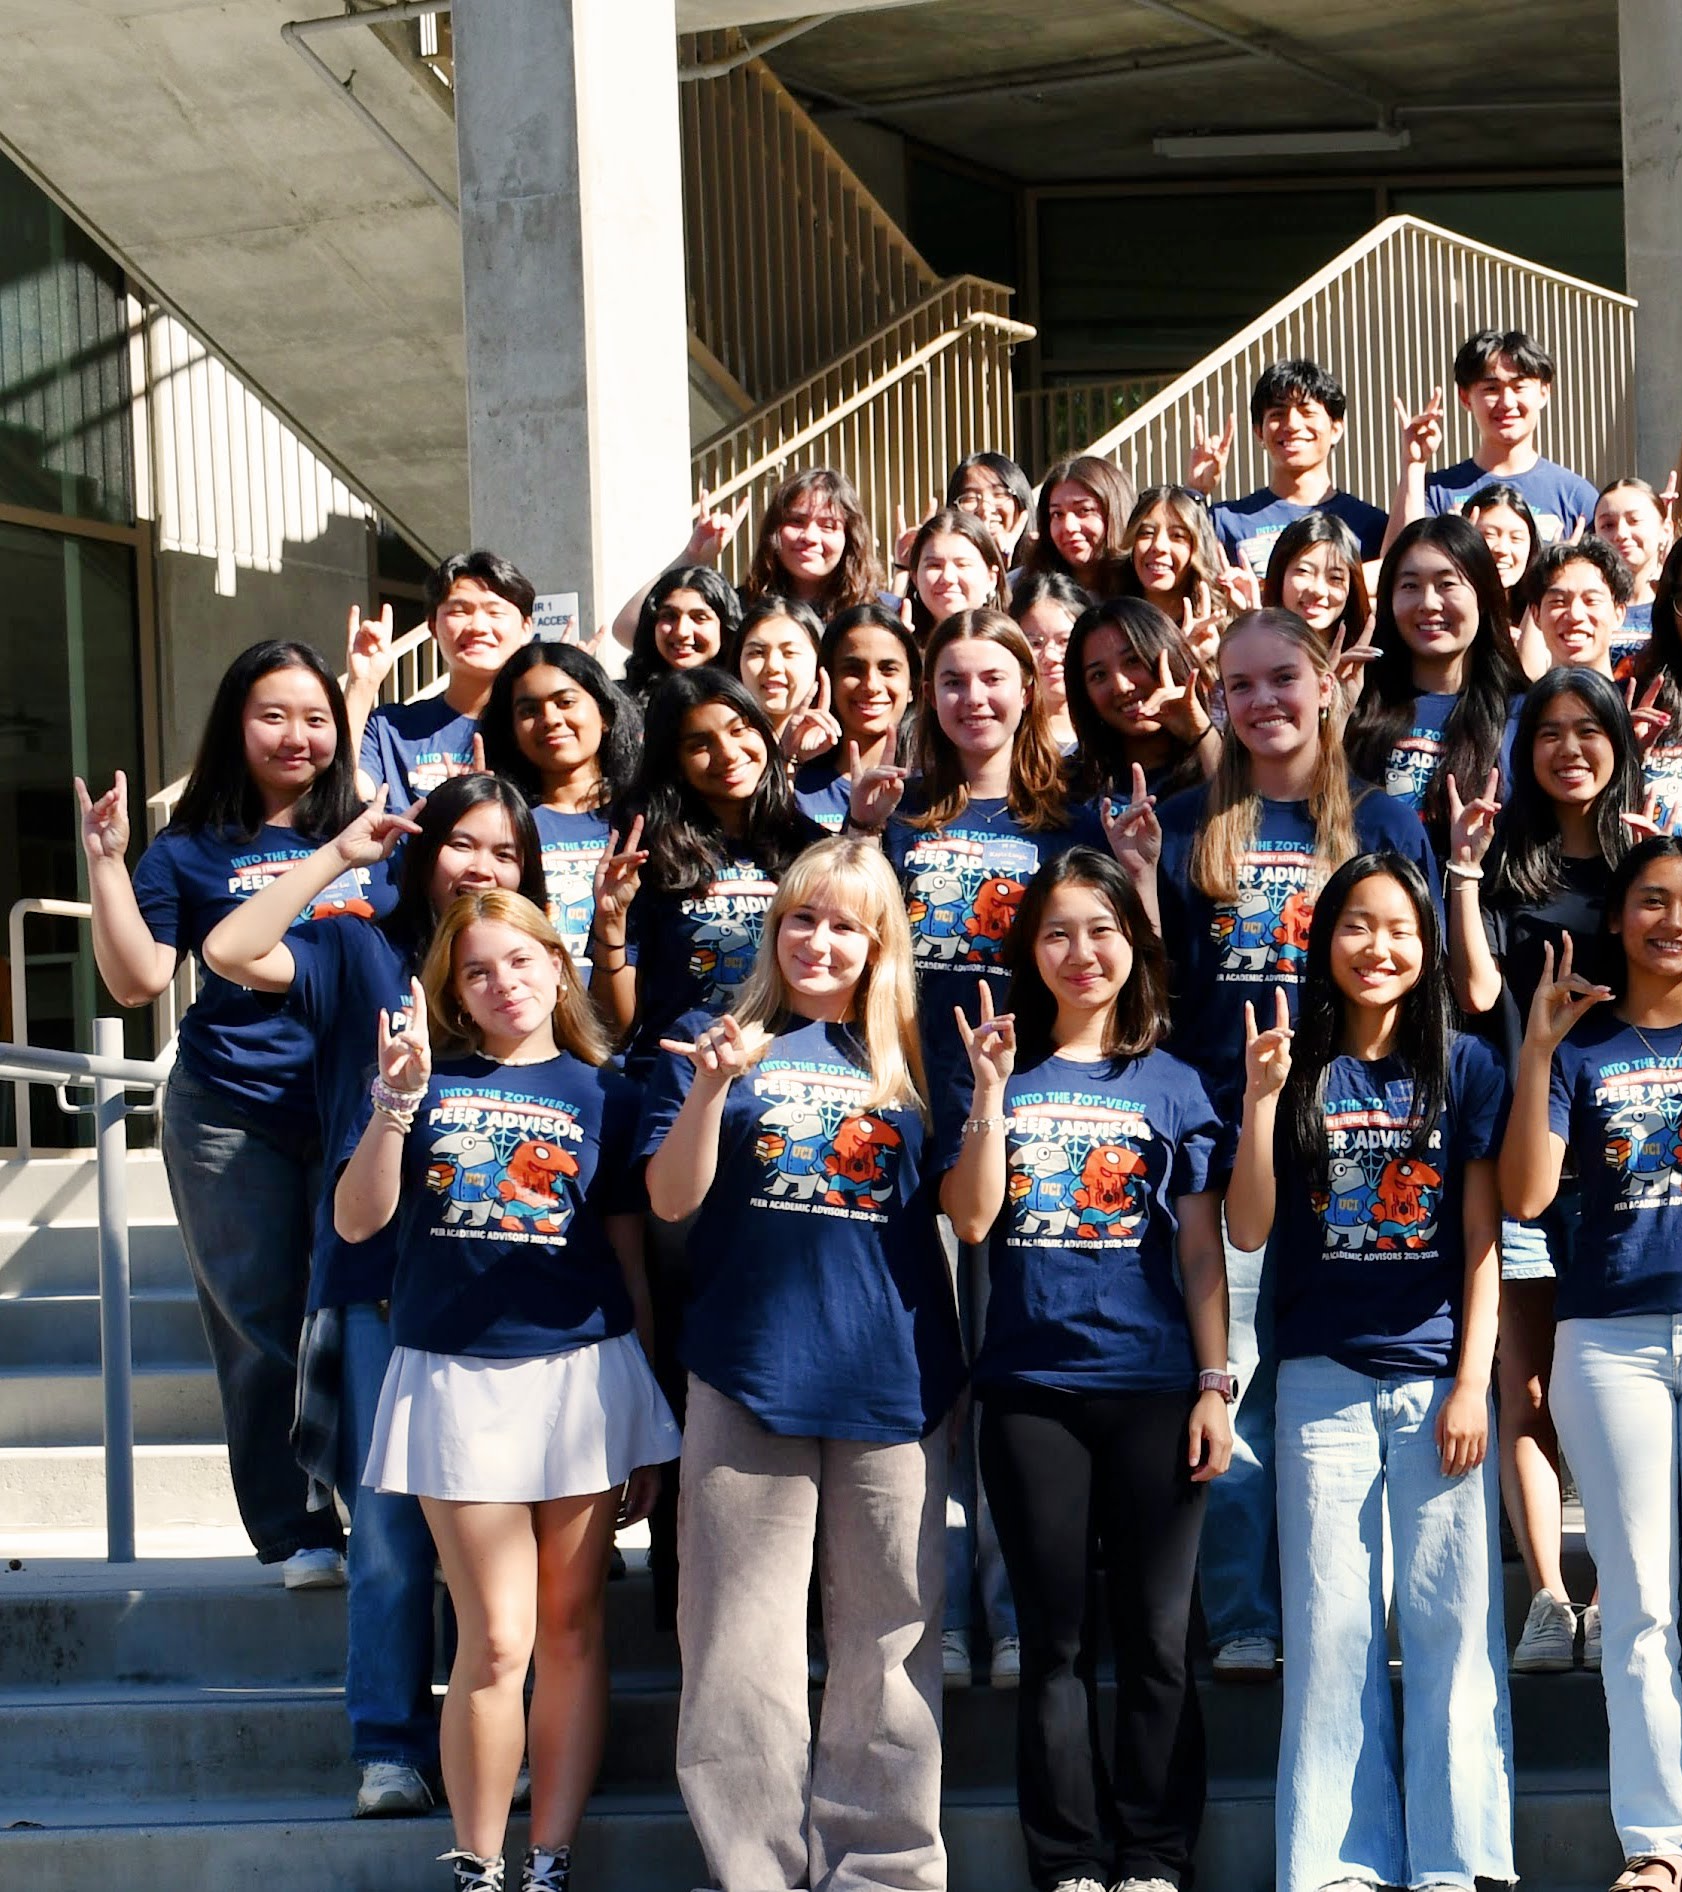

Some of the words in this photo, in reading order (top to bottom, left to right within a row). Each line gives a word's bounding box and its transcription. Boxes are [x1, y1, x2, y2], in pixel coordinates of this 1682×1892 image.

[538, 615, 571, 626] ACCES
[416, 752, 441, 764] INTO
[815, 813, 844, 823] INTO
[946, 830, 967, 840] THE
[557, 842, 579, 851] THE
[1275, 841, 1315, 854] ZOT-V
[231, 855, 261, 868] INTO
[264, 852, 288, 862] THE
[904, 850, 950, 867] PEER
[682, 896, 729, 915] PEER
[934, 910, 953, 922] UCI
[1243, 922, 1262, 933] UCI
[1225, 973, 1263, 982] ACADEMIC
[1265, 974, 1298, 984] ADVISORS
[760, 1061, 790, 1072] INTO
[793, 1062, 816, 1072] THE
[1599, 1062, 1630, 1078] INTO
[1632, 1057, 1655, 1069] THE
[754, 1079, 806, 1098] PEER
[1595, 1085, 1645, 1106] PEER
[439, 1088, 472, 1098] INTO
[476, 1089, 501, 1100] THE
[504, 1092, 581, 1117] ZOT-VERSE
[1011, 1093, 1043, 1107] INTO
[1046, 1092, 1070, 1103] THE
[1072, 1093, 1146, 1113] ZOT-VERSE
[1340, 1098, 1362, 1111] THE
[429, 1108, 480, 1125] PEER
[487, 1111, 584, 1143] ADVISOR
[1003, 1116, 1055, 1136] PEER
[1059, 1120, 1153, 1141] ADVISOR
[1355, 1130, 1442, 1149] ADVISR
[792, 1146, 812, 1159] UCI
[465, 1173, 487, 1186] UCI
[1041, 1183, 1062, 1196] UCI
[750, 1198, 768, 1208] PEER
[769, 1200, 810, 1212] ACADEMIC
[812, 1204, 849, 1218] ADVISORS
[1339, 1199, 1358, 1211] UCI
[487, 1231, 529, 1243] ADVISORS
[1064, 1239, 1103, 1249] ADVISORS
[1364, 1252, 1402, 1261] ADVISORS
